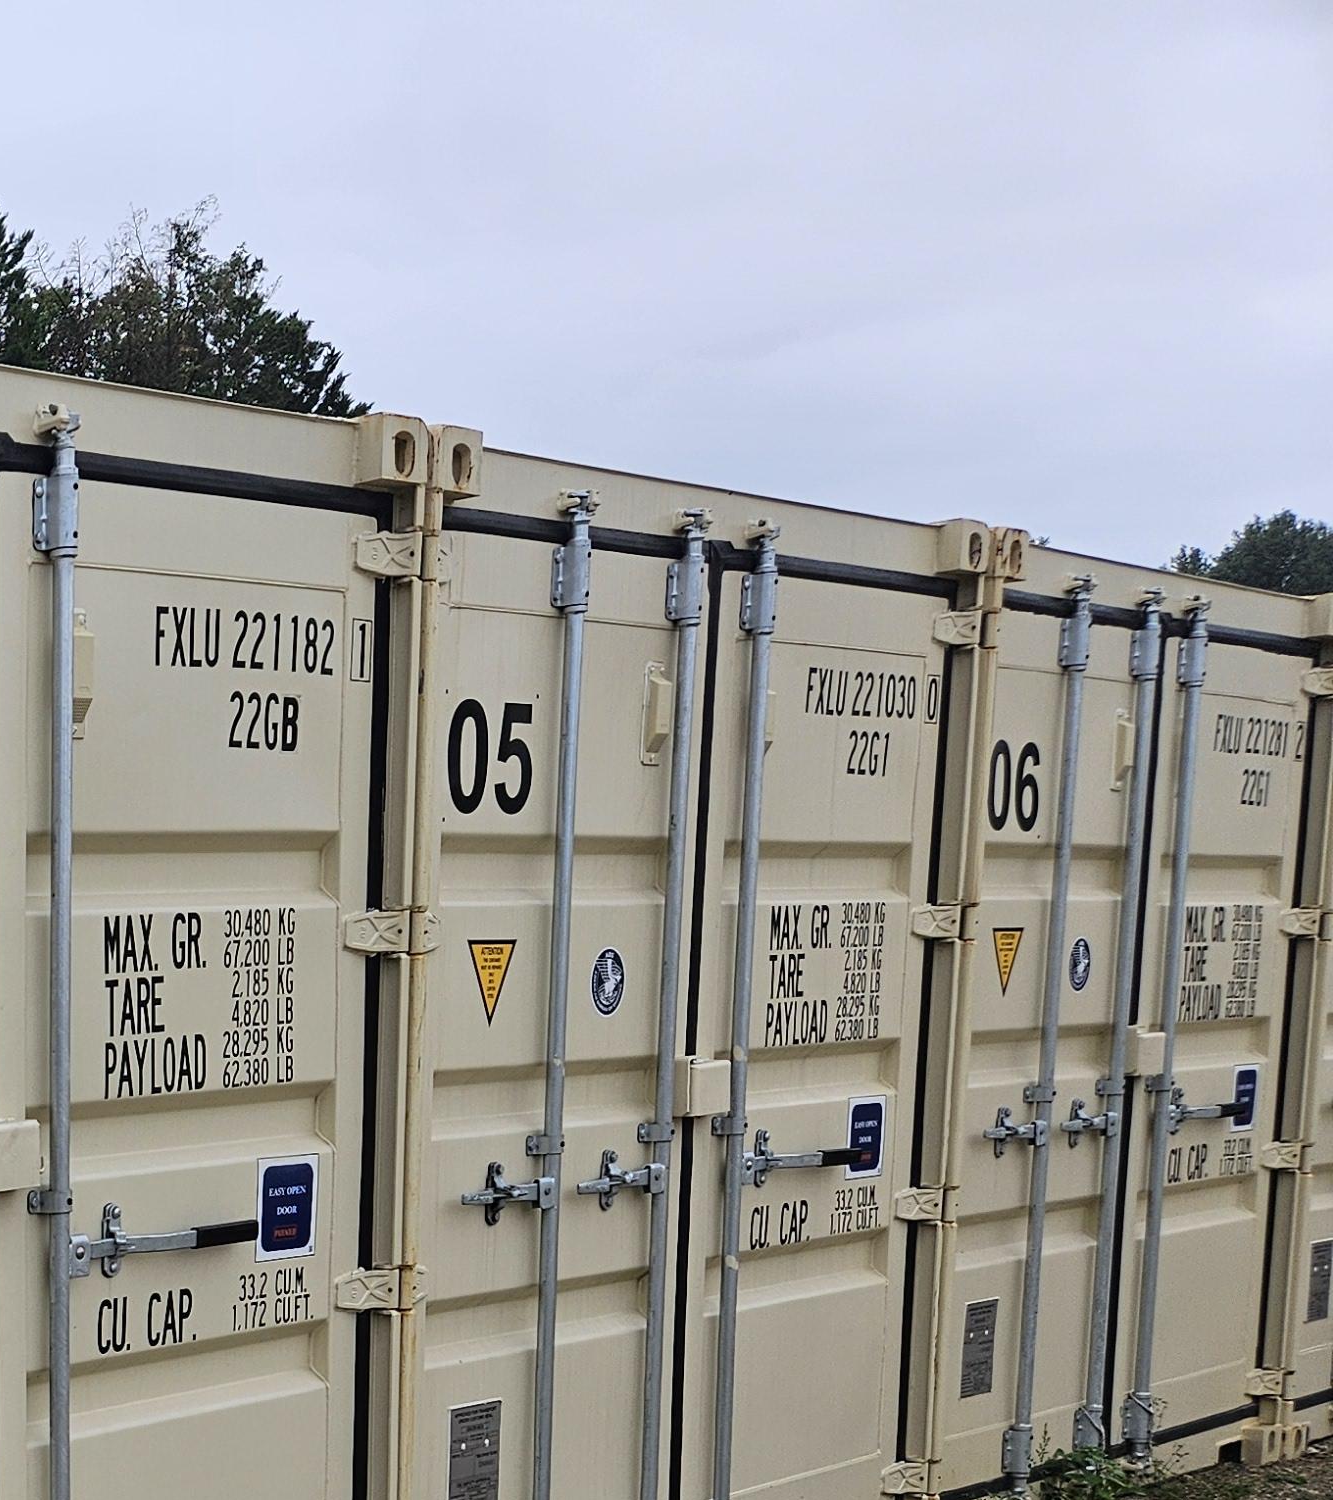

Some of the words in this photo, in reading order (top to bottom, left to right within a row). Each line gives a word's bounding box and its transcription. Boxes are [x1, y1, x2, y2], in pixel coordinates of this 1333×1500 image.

[156, 606, 220, 667] FXLU
[232, 610, 334, 675] 221182
[359, 623, 366, 678] 1
[806, 667, 848, 716] FXLU
[852, 672, 916, 719] 221030
[927, 678, 937, 720] 0
[229, 691, 299, 751] 22GB
[1213, 714, 1244, 754] FXLU
[1295, 725, 1304, 759] 2
[448, 699, 532, 815] 05
[847, 730, 889, 776] 22G1
[988, 740, 1040, 832] 06
[1241, 769, 1270, 806] 22G1
[104, 914, 158, 974] MAX.
[172, 913, 206, 969] GR.
[224, 909, 270, 937] 30,480
[279, 908, 295, 935] KG
[770, 905, 802, 950] MAX.
[811, 905, 831, 948] GR.
[874, 902, 885, 923] KG
[873, 925, 884, 947] LB
[224, 938, 269, 968] 67,200
[278, 937, 294, 965] LB
[769, 953, 805, 999] TARE
[871, 949, 882, 969] KG
[105, 976, 165, 1037] TARE
[232, 968, 269, 998] 2,185
[277, 967, 293, 995] KG
[870, 972, 880, 993] LB
[232, 999, 268, 1028] 4,820
[277, 997, 293, 1025] LB
[765, 1000, 827, 1047] PAYLOAD
[869, 995, 879, 1016] KG
[868, 1018, 878, 1039] LB
[105, 1034, 206, 1099] PAYLOAD
[223, 1028, 268, 1058] 28,295
[277, 1026, 293, 1054] KG
[223, 1058, 268, 1088] 62,380
[277, 1056, 293, 1083] LB
[269, 1187, 286, 1196] EASY
[287, 1185, 307, 1195] OPEN
[277, 1206, 297, 1215] DOOR
[835, 1189, 853, 1211] 33.2
[750, 1205, 770, 1250] CU.
[780, 1200, 809, 1245] CAP.
[239, 1272, 267, 1301] 33.2
[275, 1267, 307, 1296] CU.M.
[98, 1297, 130, 1354] CU.
[147, 1288, 196, 1346] CAP.
[275, 1294, 314, 1324] CU.FT.
